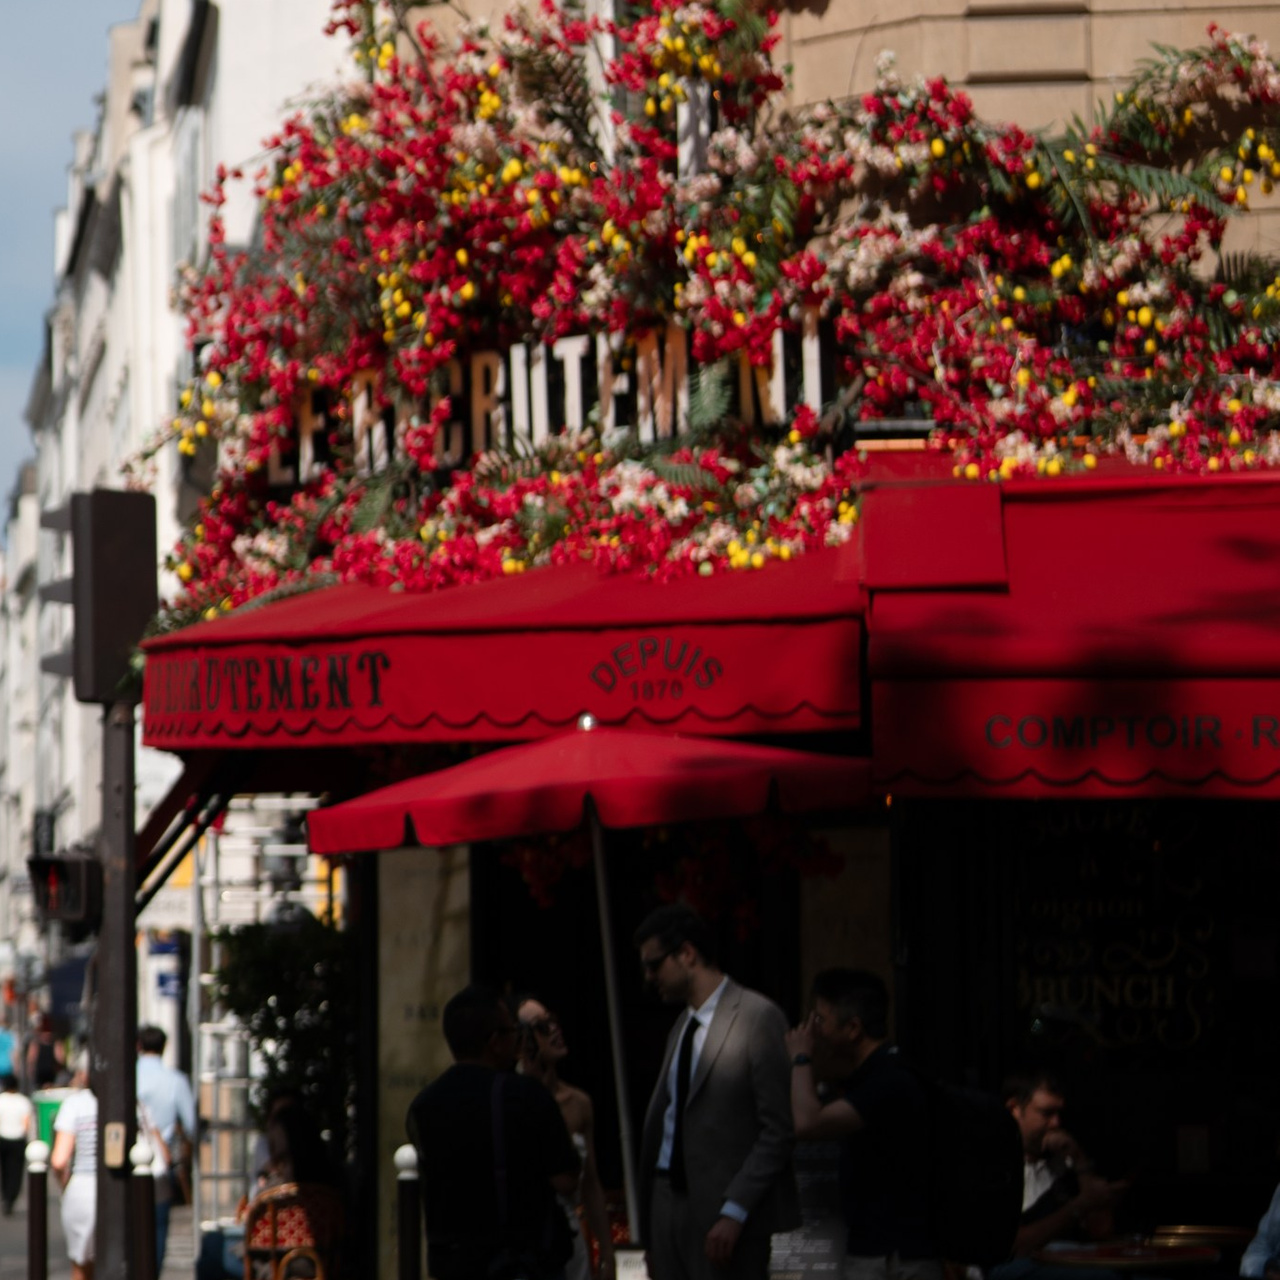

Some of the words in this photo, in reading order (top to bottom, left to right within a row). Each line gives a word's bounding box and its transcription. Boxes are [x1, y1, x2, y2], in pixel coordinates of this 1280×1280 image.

[351, 305, 826, 480] RCRUTEMN
[589, 636, 723, 693] DEPUIS
[983, 713, 1223, 750] COMPTOIR
